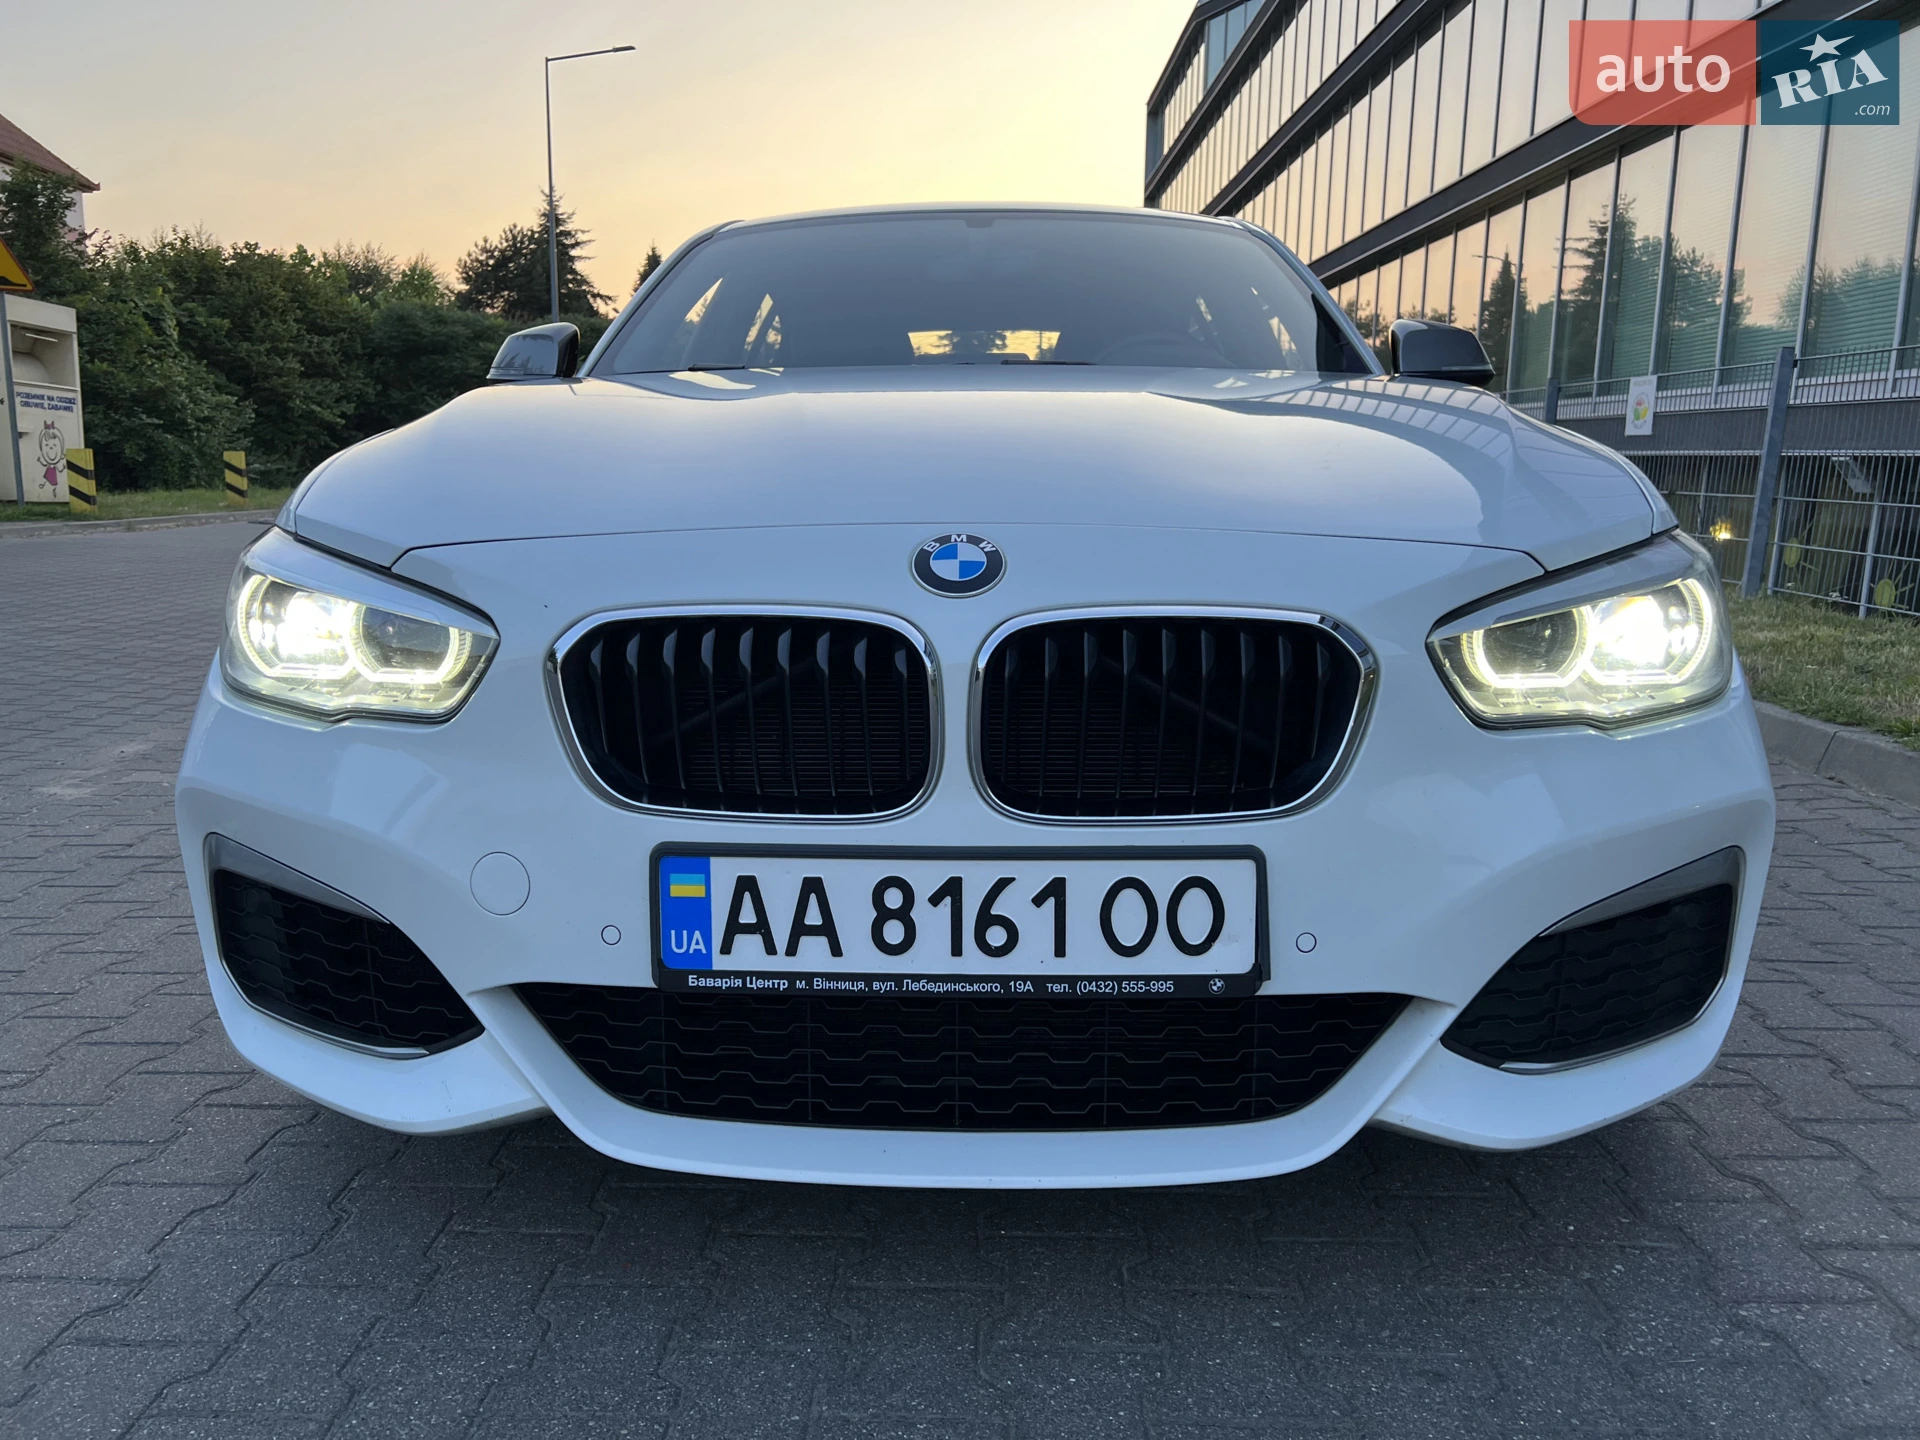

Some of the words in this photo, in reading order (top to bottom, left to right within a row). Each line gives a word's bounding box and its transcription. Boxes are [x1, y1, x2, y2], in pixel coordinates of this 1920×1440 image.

[922, 534, 997, 552] BMW
[719, 874, 844, 958] AA
[870, 875, 1067, 958] 8161
[670, 929, 707, 954] UA
[688, 975, 743, 990] Баварія
[746, 976, 789, 991] Центр
[796, 979, 809, 989] м.
[813, 977, 868, 992] Вінниця,
[872, 981, 899, 993] вул.
[902, 979, 1004, 994] Лебединського,
[1046, 982, 1072, 993] тел.
[1076, 980, 1118, 995] (0432)
[1121, 980, 1174, 993] 555-995
